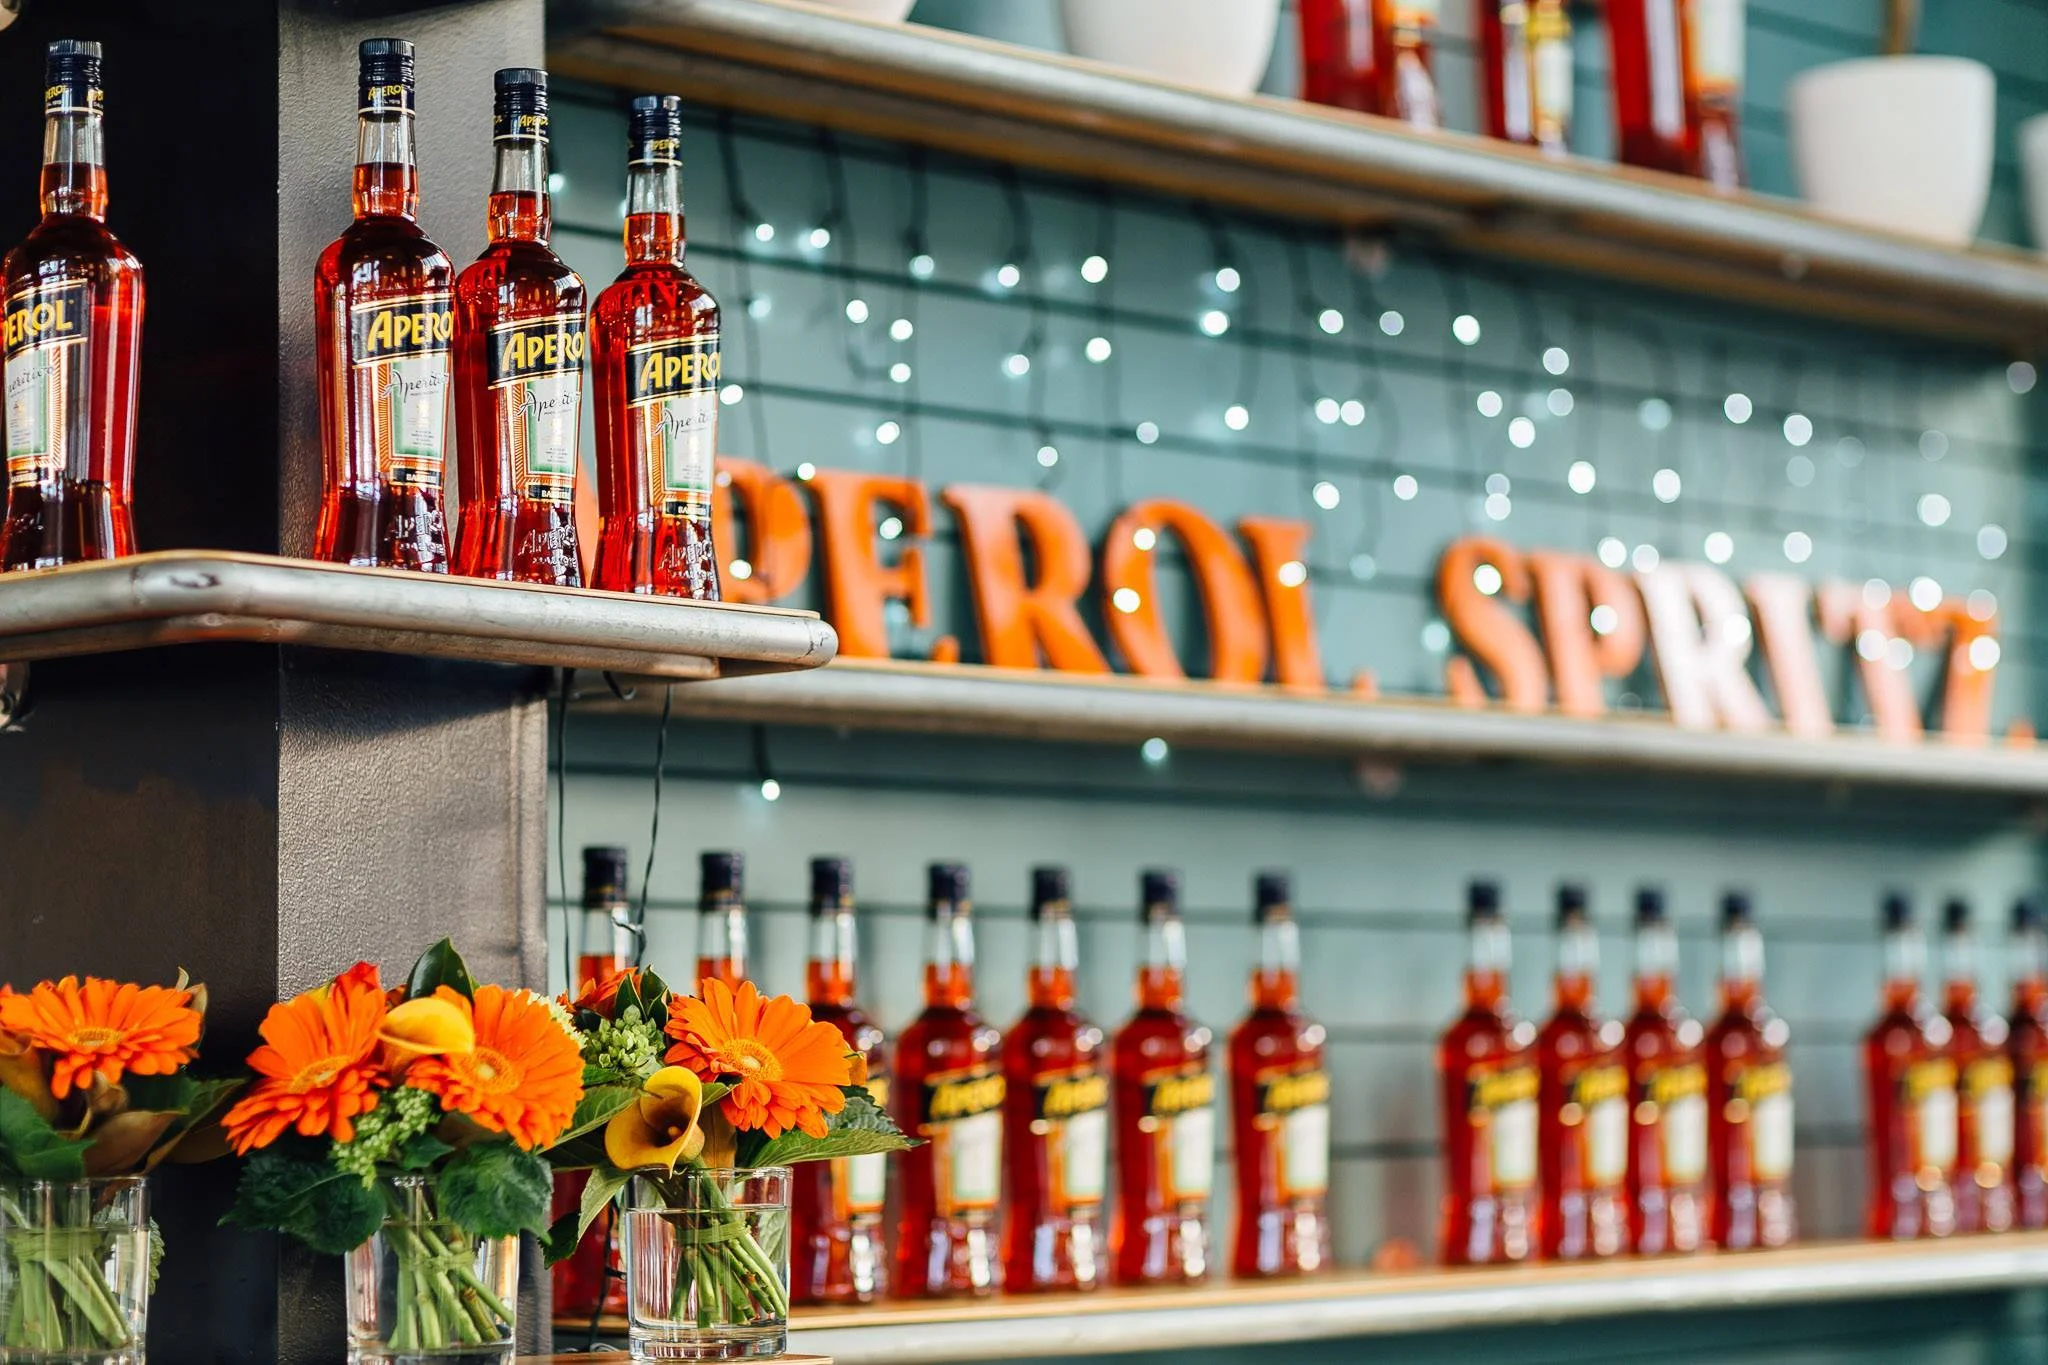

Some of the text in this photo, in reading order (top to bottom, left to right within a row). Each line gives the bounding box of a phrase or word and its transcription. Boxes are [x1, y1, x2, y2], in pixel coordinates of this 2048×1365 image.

[3, 299, 73, 352] PEROL
[574, 458, 2036, 750] PEROL SPRITZ
